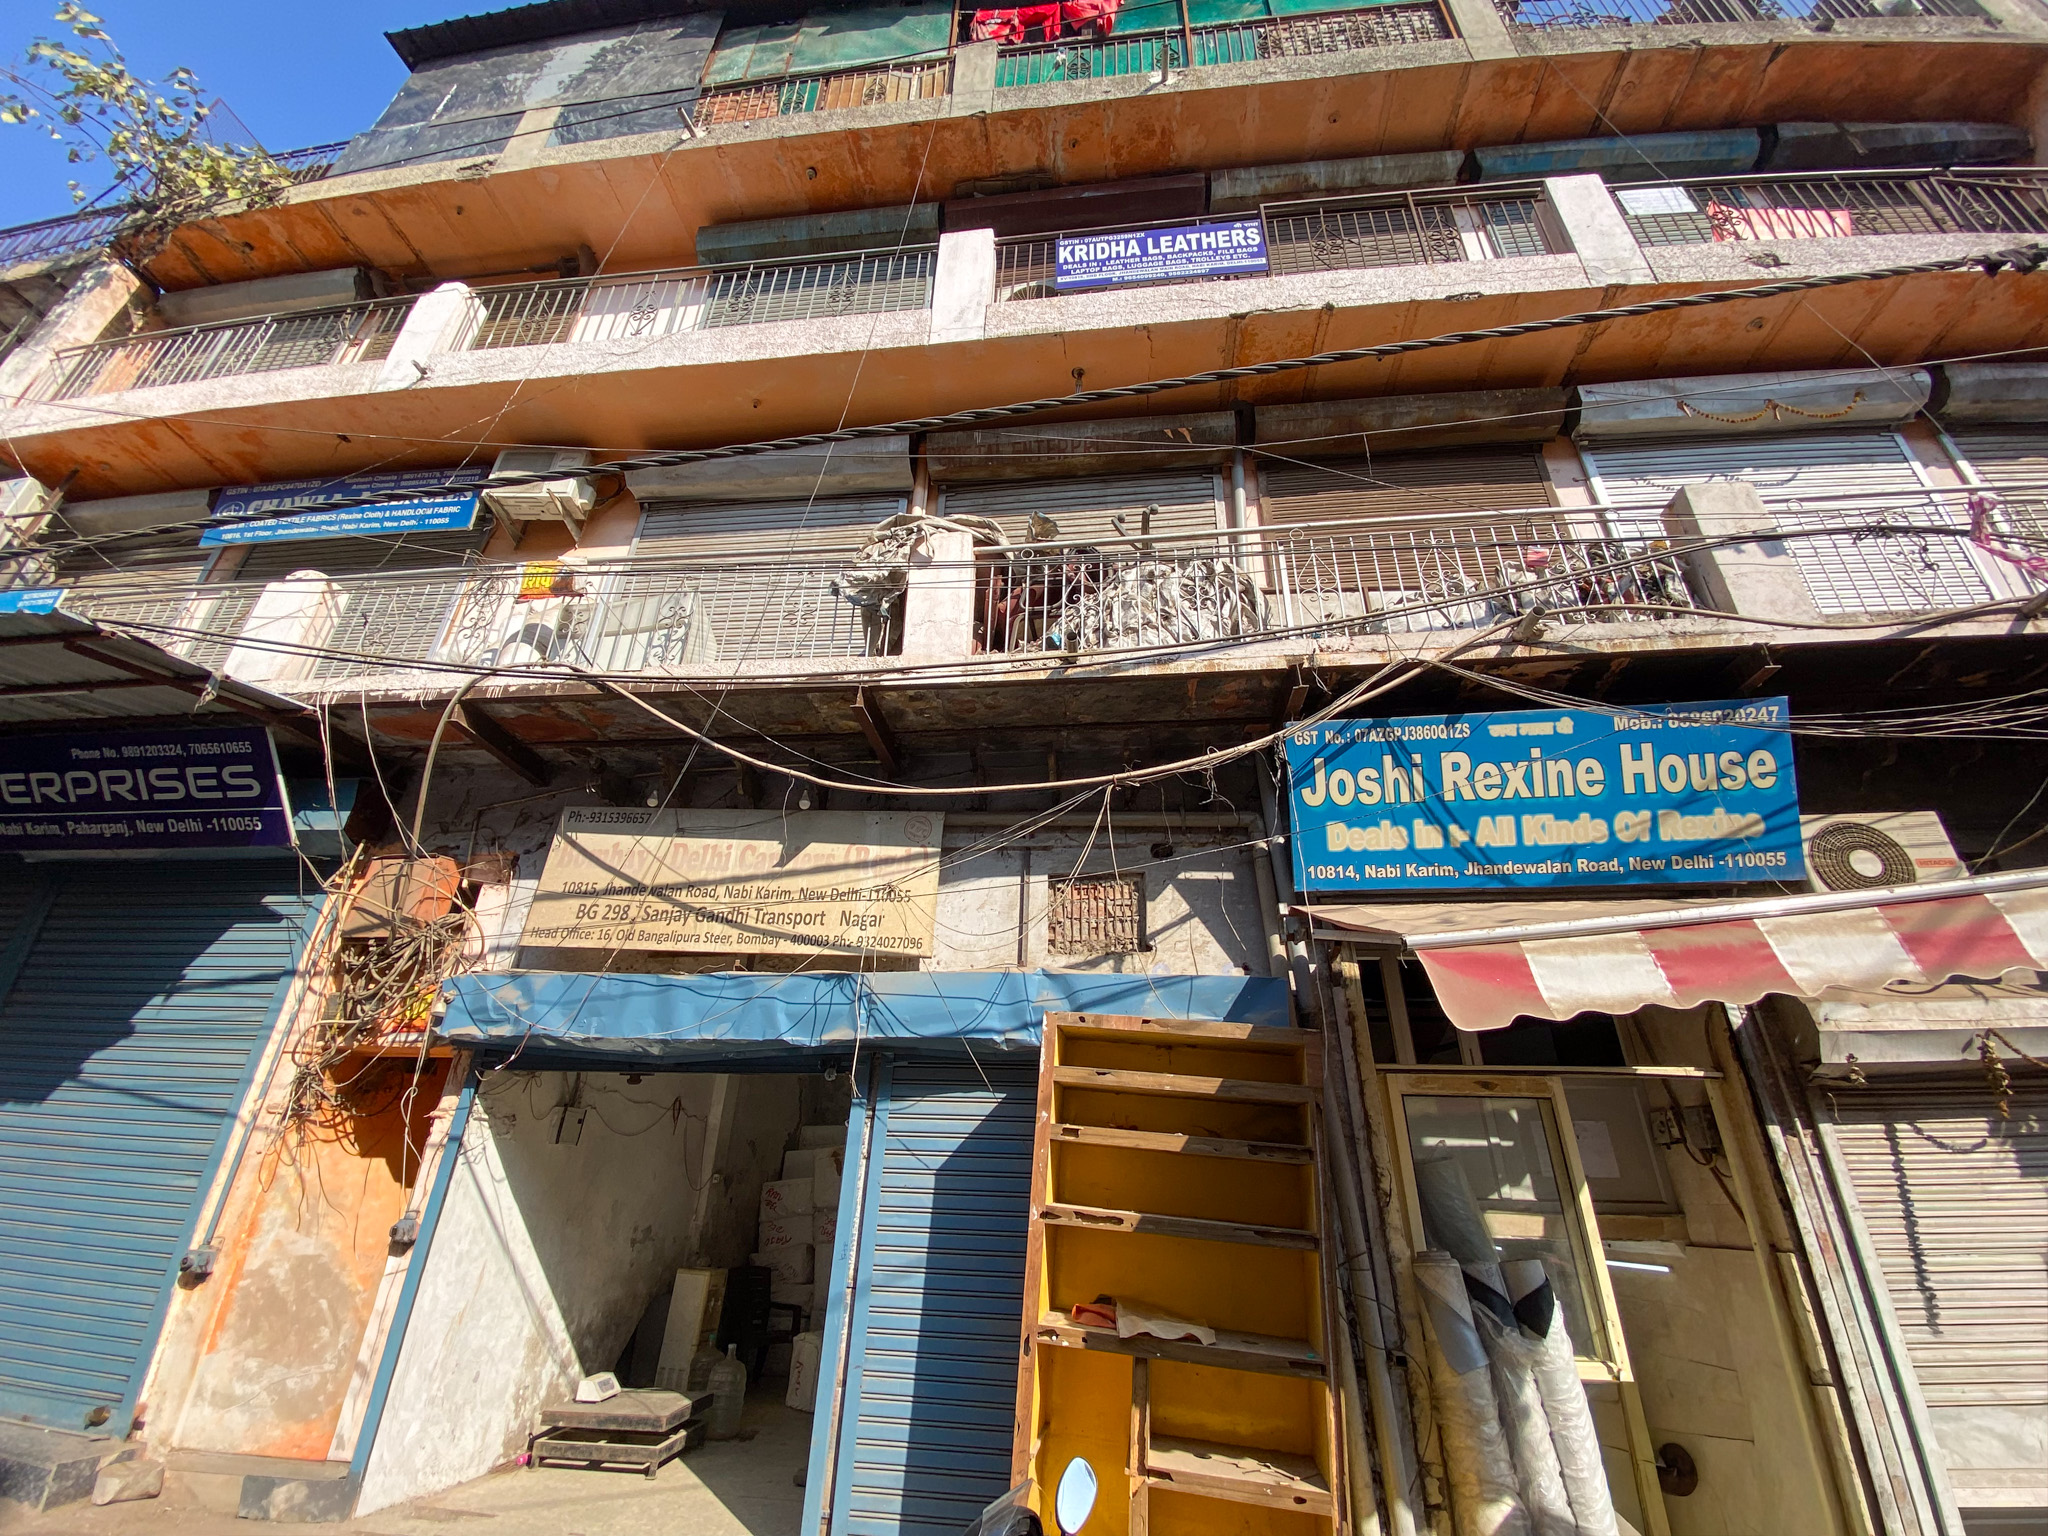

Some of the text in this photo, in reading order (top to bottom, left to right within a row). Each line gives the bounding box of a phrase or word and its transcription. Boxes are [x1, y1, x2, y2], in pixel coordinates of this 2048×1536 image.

[1058, 228, 1261, 263] KRIDHA LEATHERS
[1062, 262, 1087, 270] DEALS
[1106, 258, 1140, 266] LEATHER
[1142, 254, 1166, 262] BAGS,
[1167, 250, 1216, 260] BACKPACKS,
[1236, 246, 1258, 254] BAGS
[1070, 266, 1101, 275] LAPTOP
[1102, 264, 1126, 272] BAGS,
[1127, 260, 1164, 269] LUGGAGE
[1166, 258, 1189, 266] BAGS,
[1190, 254, 1231, 263] TROLLEYS
[250, 520, 278, 528] COATED
[306, 514, 337, 523] FABRICS
[434, 506, 461, 514] FABRIC
[383, 520, 399, 528] New
[1294, 730, 1319, 746] GST
[71, 748, 101, 760] Phone
[102, 746, 120, 759] No.
[0, 765, 262, 804] ERPRISES
[1301, 742, 1779, 808] Joshi Rexine House
[25, 822, 65, 837] Karim,
[67, 820, 134, 837] Paharganj,
[136, 820, 165, 833] New
[168, 818, 203, 832] Delhi
[1326, 819, 1409, 853] Deals
[1476, 815, 1517, 848] All
[1522, 812, 1610, 846] Kinds
[1614, 810, 1652, 843] Of
[1657, 808, 1766, 843] Rexine
[669, 842, 734, 872] Delhi
[1307, 852, 1787, 882] 10814, Nabi Karim, Jhandewalan Road, New Delhi -110055
[562, 881, 600, 897] 10815,
[602, 882, 683, 898] Jhandewalan
[686, 884, 720, 901] Road,
[724, 886, 753, 899] Nabi
[756, 886, 795, 901] Karim,
[800, 886, 827, 901] New
[576, 904, 599, 921] BG
[641, 904, 691, 927] Sanjay
[694, 906, 749, 926] Gandhi
[754, 908, 826, 929] Transport
[840, 910, 885, 931] Nagar
[530, 926, 557, 939] Head
[597, 928, 613, 943] 16,
[616, 928, 634, 942] Old
[637, 930, 701, 946] Bangalipura
[702, 931, 733, 946] Steer,
[736, 932, 781, 948] Bombay
[790, 934, 830, 947] 400003
